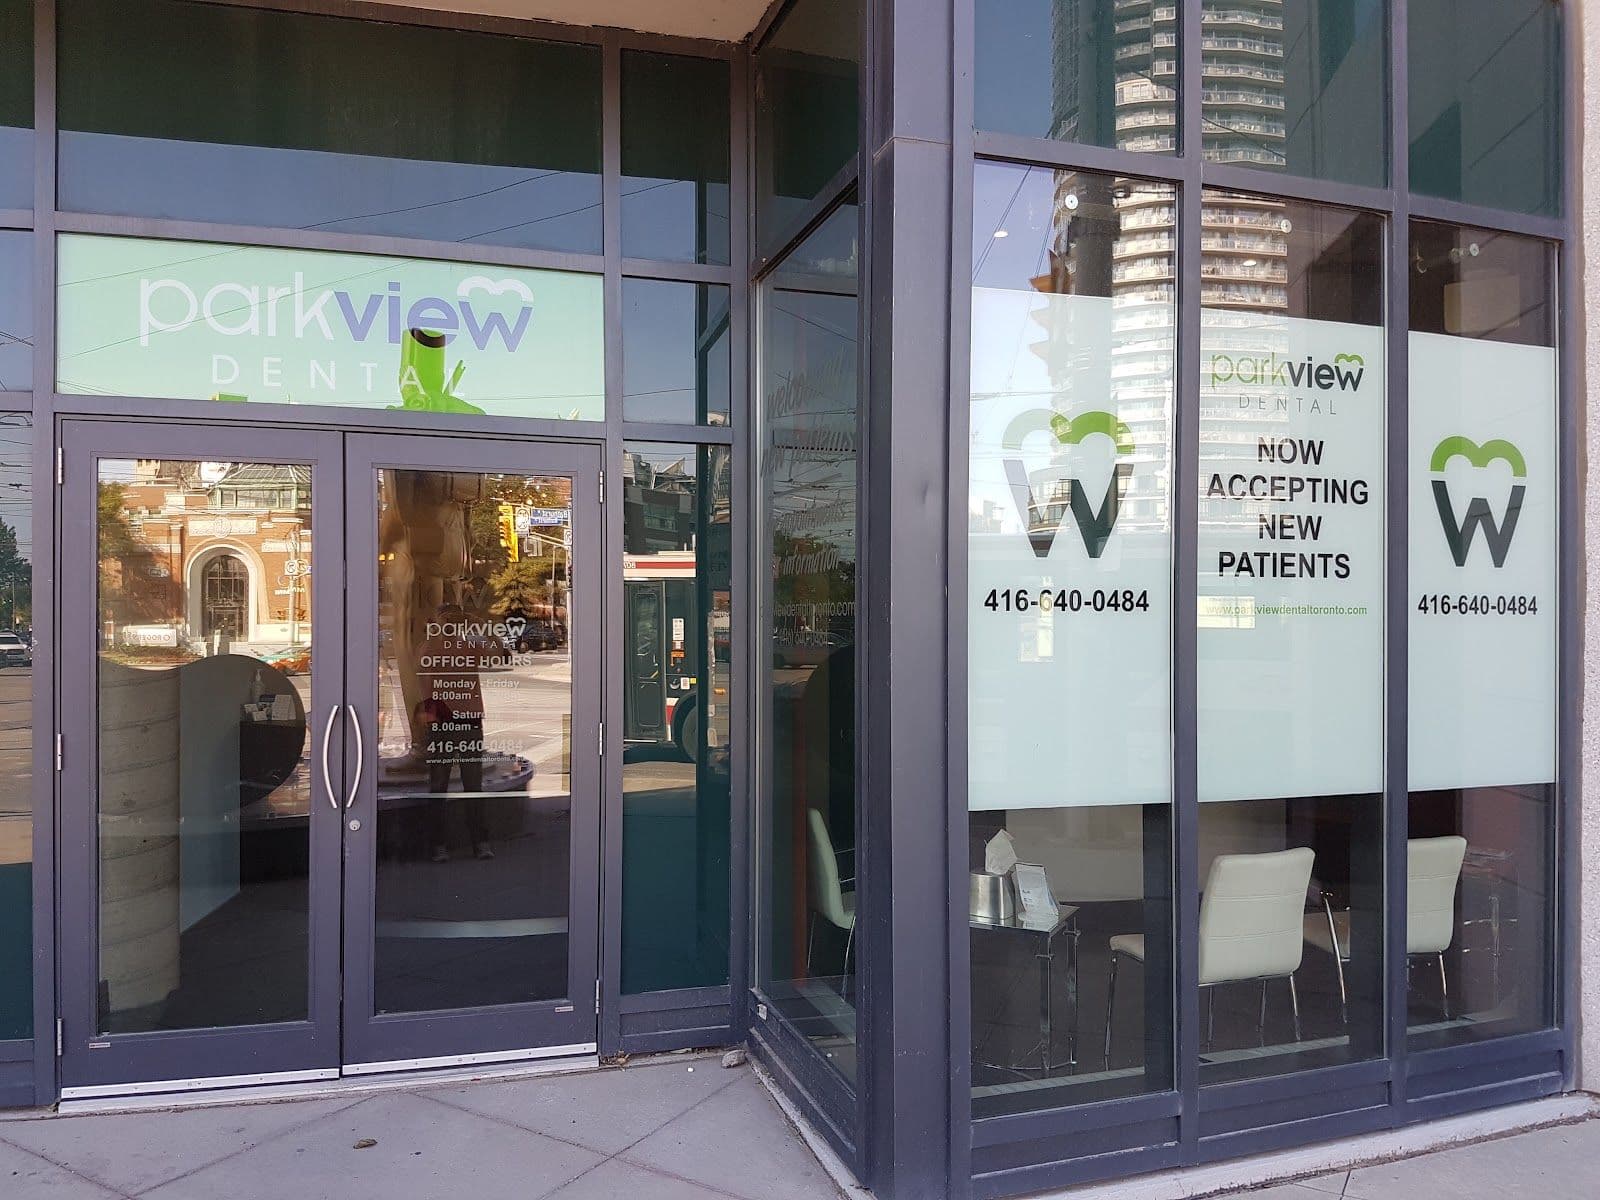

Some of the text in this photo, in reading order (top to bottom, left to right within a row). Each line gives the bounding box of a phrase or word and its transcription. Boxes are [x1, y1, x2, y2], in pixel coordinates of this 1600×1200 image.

[139, 272, 533, 352] parkview
[212, 354, 465, 397] DENTAL
[1211, 352, 1365, 392] parkview
[1239, 393, 1337, 415] DENTAL
[1258, 437, 1324, 465] NOW
[1206, 473, 1369, 505] ACCEPTING
[1259, 514, 1323, 541] NEW
[1218, 552, 1351, 579] PATIENTS
[984, 589, 1149, 612] 416-640-0484
[1418, 594, 1538, 615] 416-640-0484
[427, 617, 526, 640] parkview
[420, 655, 532, 668] OFFICE HOURS
[432, 691, 472, 701] 8:00am
[433, 679, 476, 690] Monday
[486, 679, 520, 690] Friday
[427, 740, 523, 754] 416-640-0484
